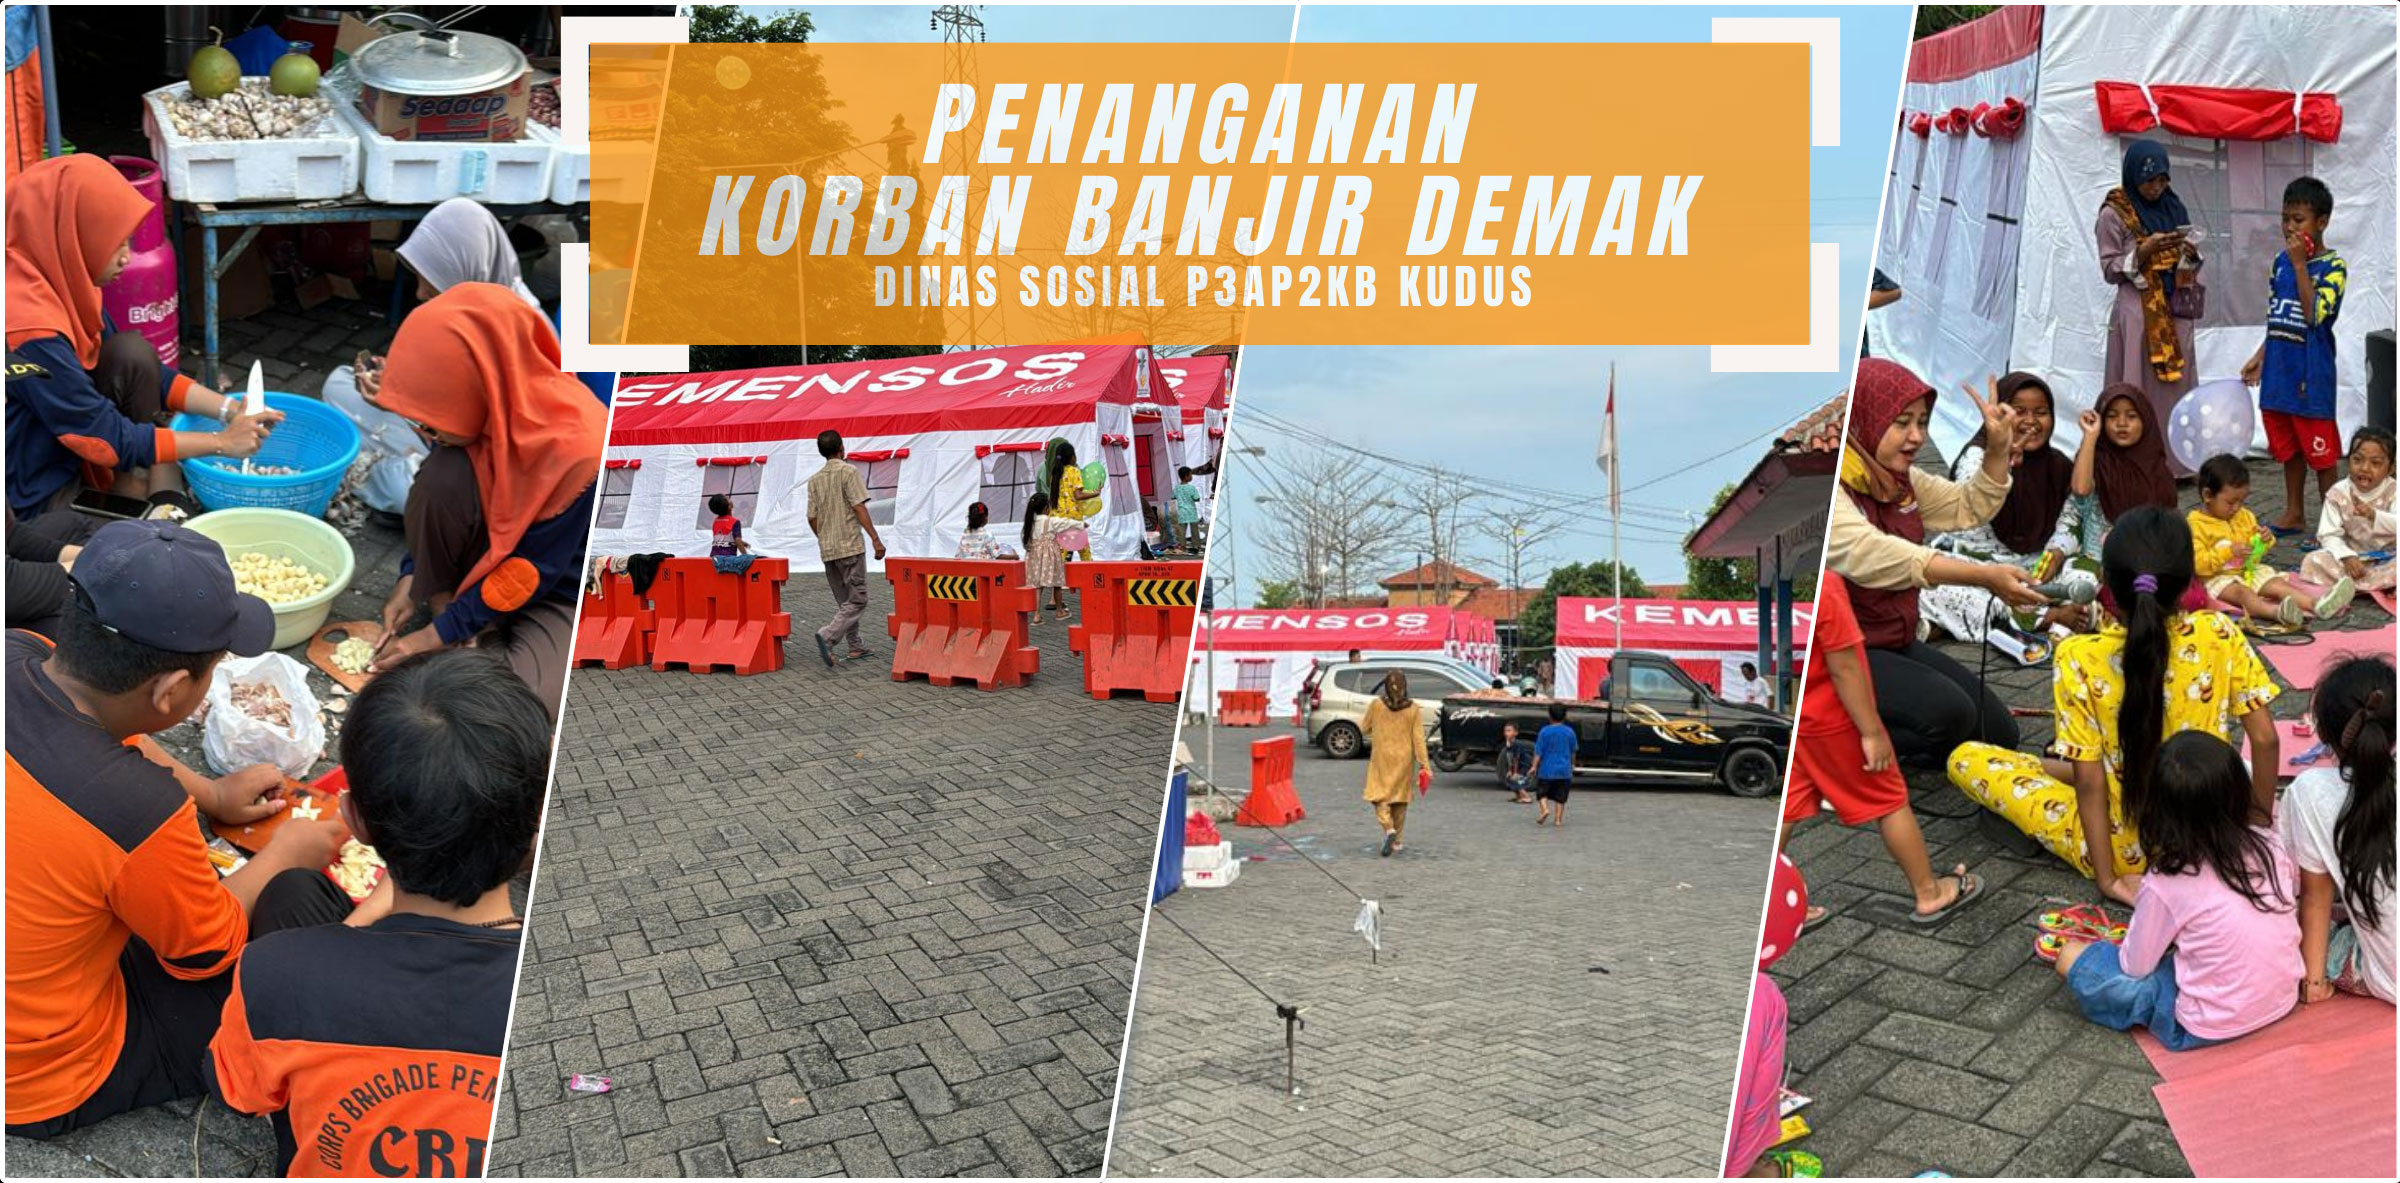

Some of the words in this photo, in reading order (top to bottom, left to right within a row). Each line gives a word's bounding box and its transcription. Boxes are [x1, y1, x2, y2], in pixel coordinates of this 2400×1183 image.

[999, 376, 1077, 398] Hadir
[317, 1112, 352, 1171] CORPS
[339, 1062, 441, 1121] BRIGADE
